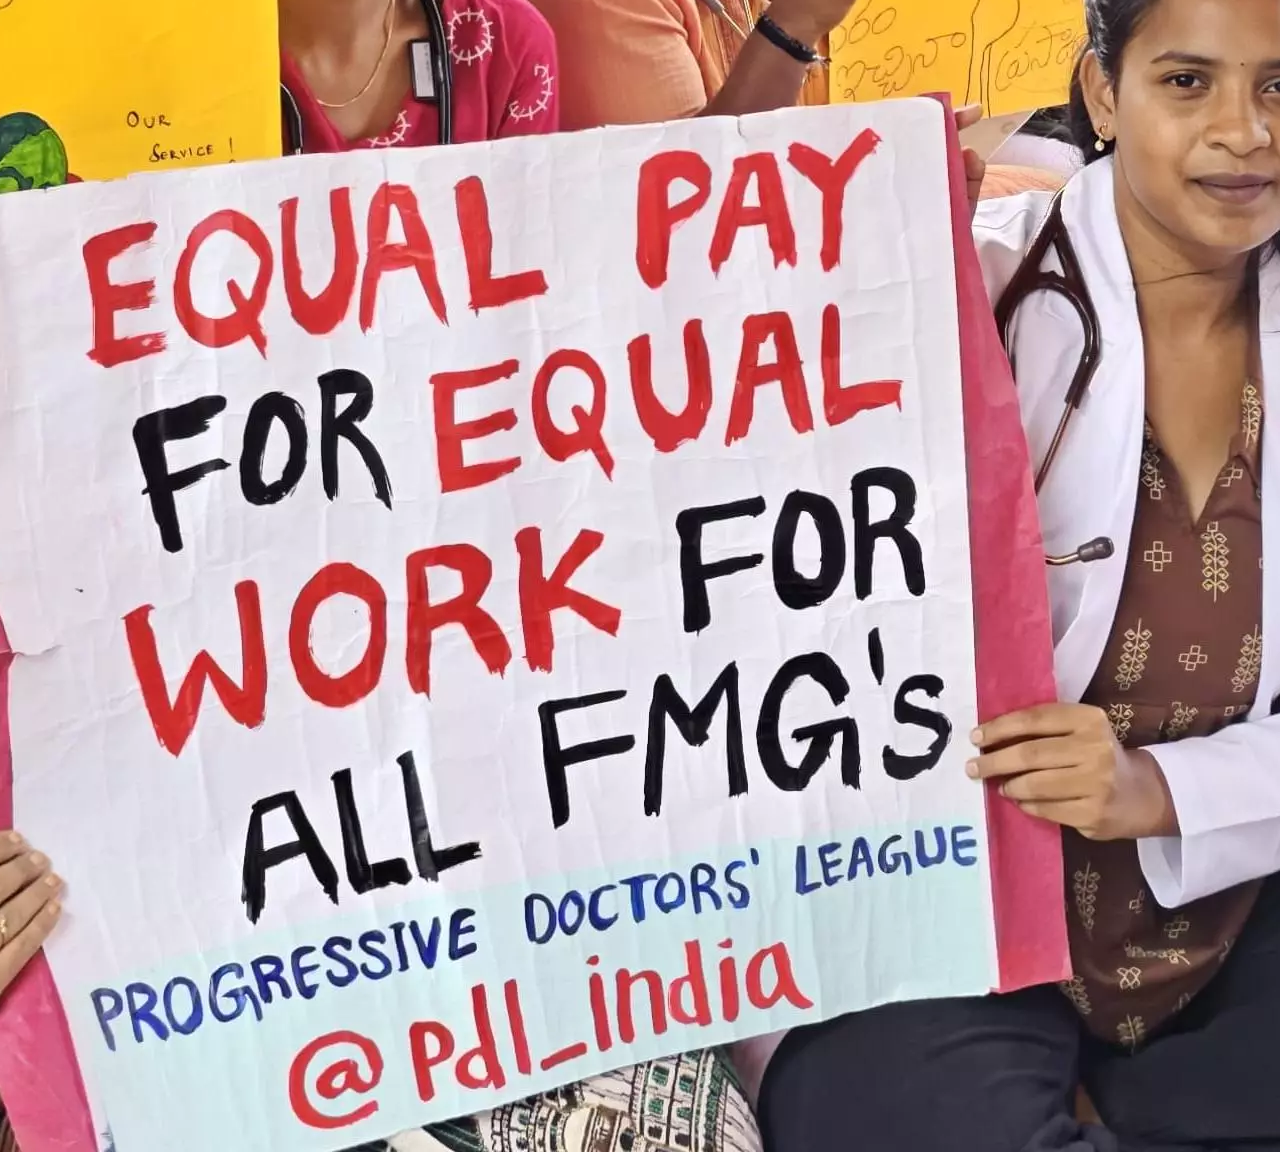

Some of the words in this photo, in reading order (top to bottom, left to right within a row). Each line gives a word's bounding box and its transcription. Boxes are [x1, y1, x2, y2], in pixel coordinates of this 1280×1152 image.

[126, 110, 172, 129] OUR
[82, 176, 547, 368] EQUAL
[634, 127, 882, 289] PAY
[132, 369, 392, 553] FOR
[430, 304, 902, 493] EQUAL
[123, 526, 621, 758] WORK
[676, 466, 927, 634] FOR
[91, 908, 478, 1051] PROGRESSIVE
[523, 851, 762, 944] DOCTORS'
[793, 826, 979, 897] LEAGUE
[241, 751, 481, 923] ALL
